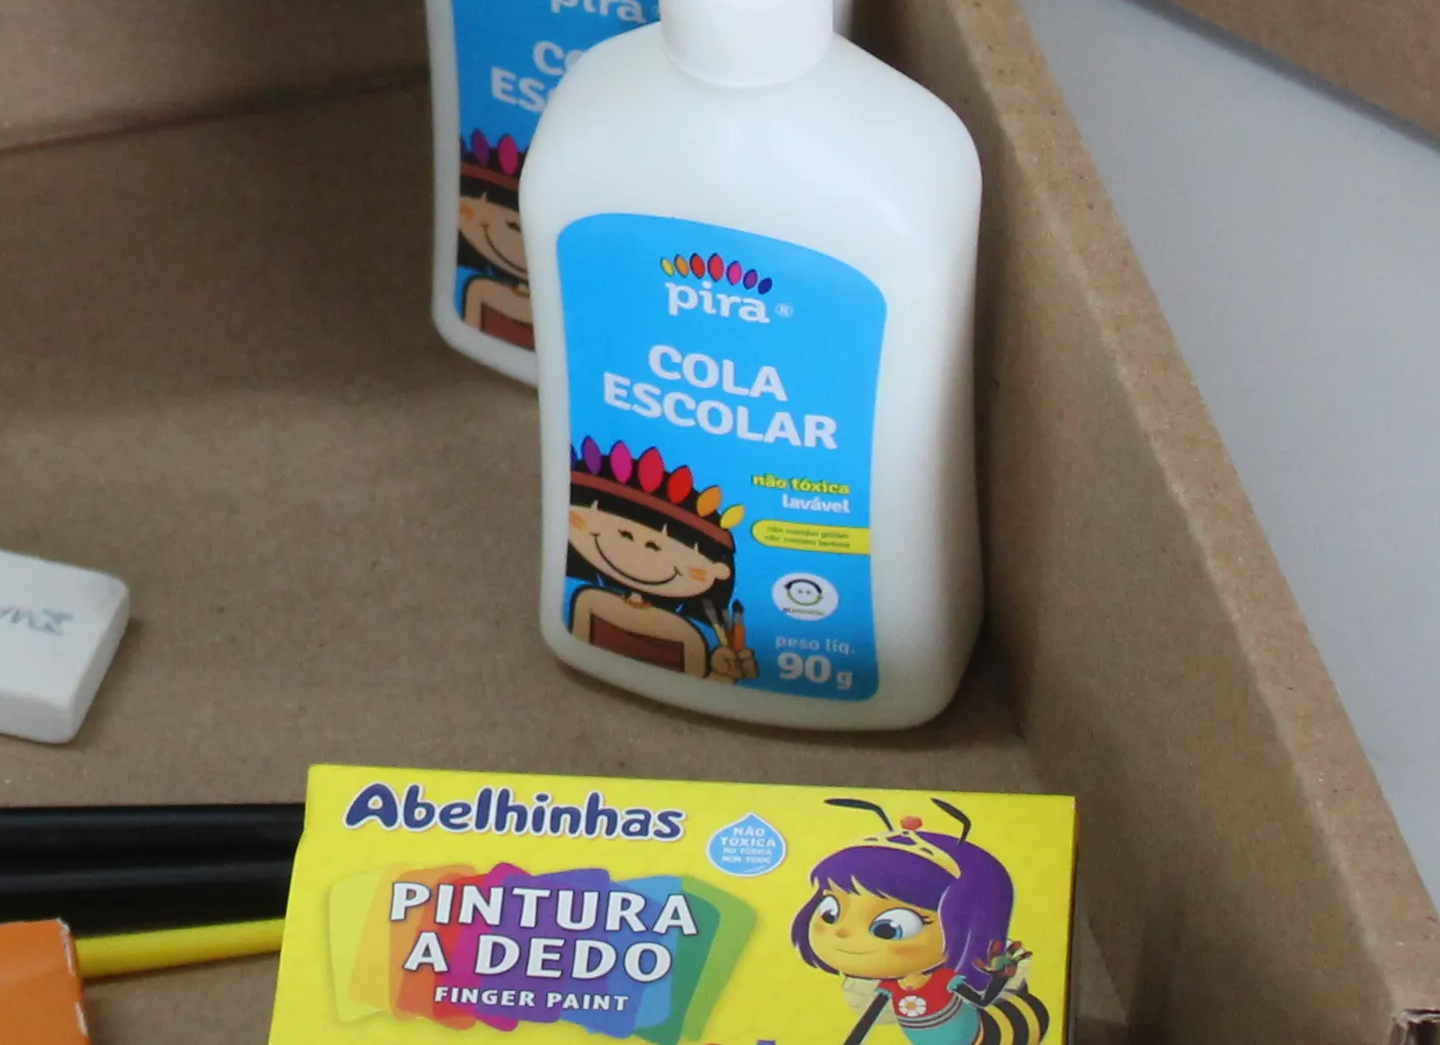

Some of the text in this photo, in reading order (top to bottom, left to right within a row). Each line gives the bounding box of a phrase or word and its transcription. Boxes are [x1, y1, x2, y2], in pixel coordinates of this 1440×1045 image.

[665, 281, 770, 323] pira
[648, 344, 789, 402] COLA
[603, 371, 838, 450] ESCOLAR
[752, 473, 850, 495] não tóxica
[782, 493, 850, 513] lavável
[775, 636, 820, 651] peso
[777, 651, 853, 690] 90 g
[344, 782, 685, 840] Abelhinhas
[389, 881, 698, 936] PINTURA
[403, 931, 673, 983] A DEDO
[434, 986, 629, 1011] FINGER PAINT
